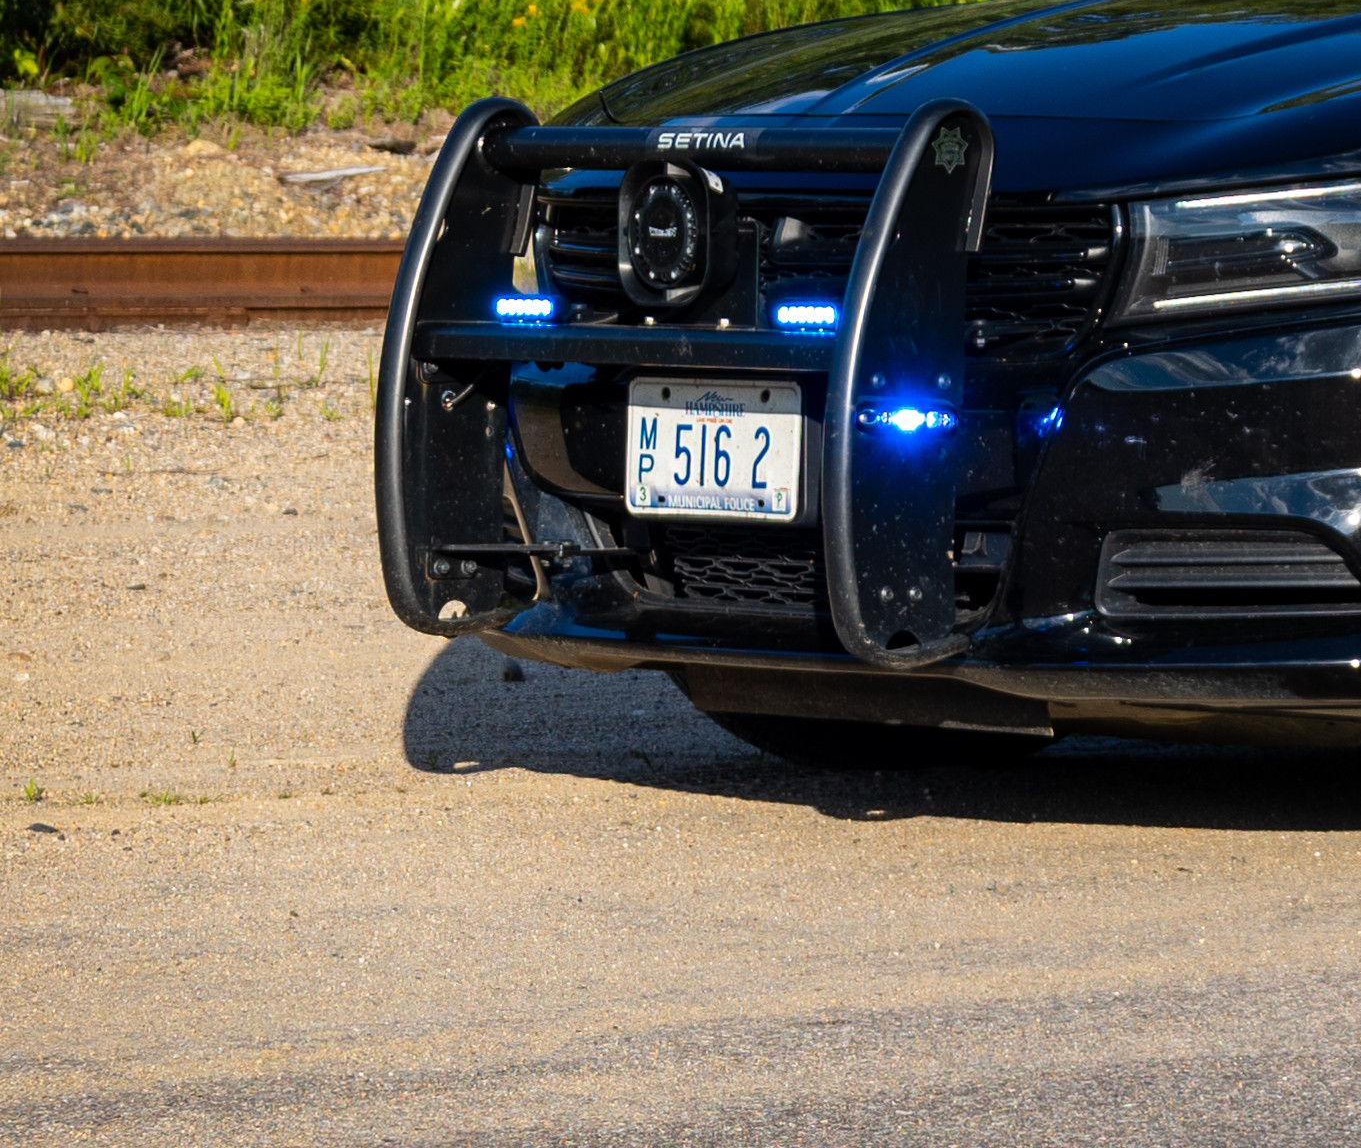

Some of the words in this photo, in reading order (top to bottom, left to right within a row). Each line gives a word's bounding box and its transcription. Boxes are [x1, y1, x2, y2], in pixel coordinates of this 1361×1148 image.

[657, 132, 745, 149] SETINA
[685, 401, 745, 417] HAMPSHIRE
[673, 424, 731, 487] 516
[752, 426, 770, 489] 2
[639, 487, 647, 502] 3
[667, 495, 723, 509] MUNICIPAL
[724, 497, 755, 512] POLICE
